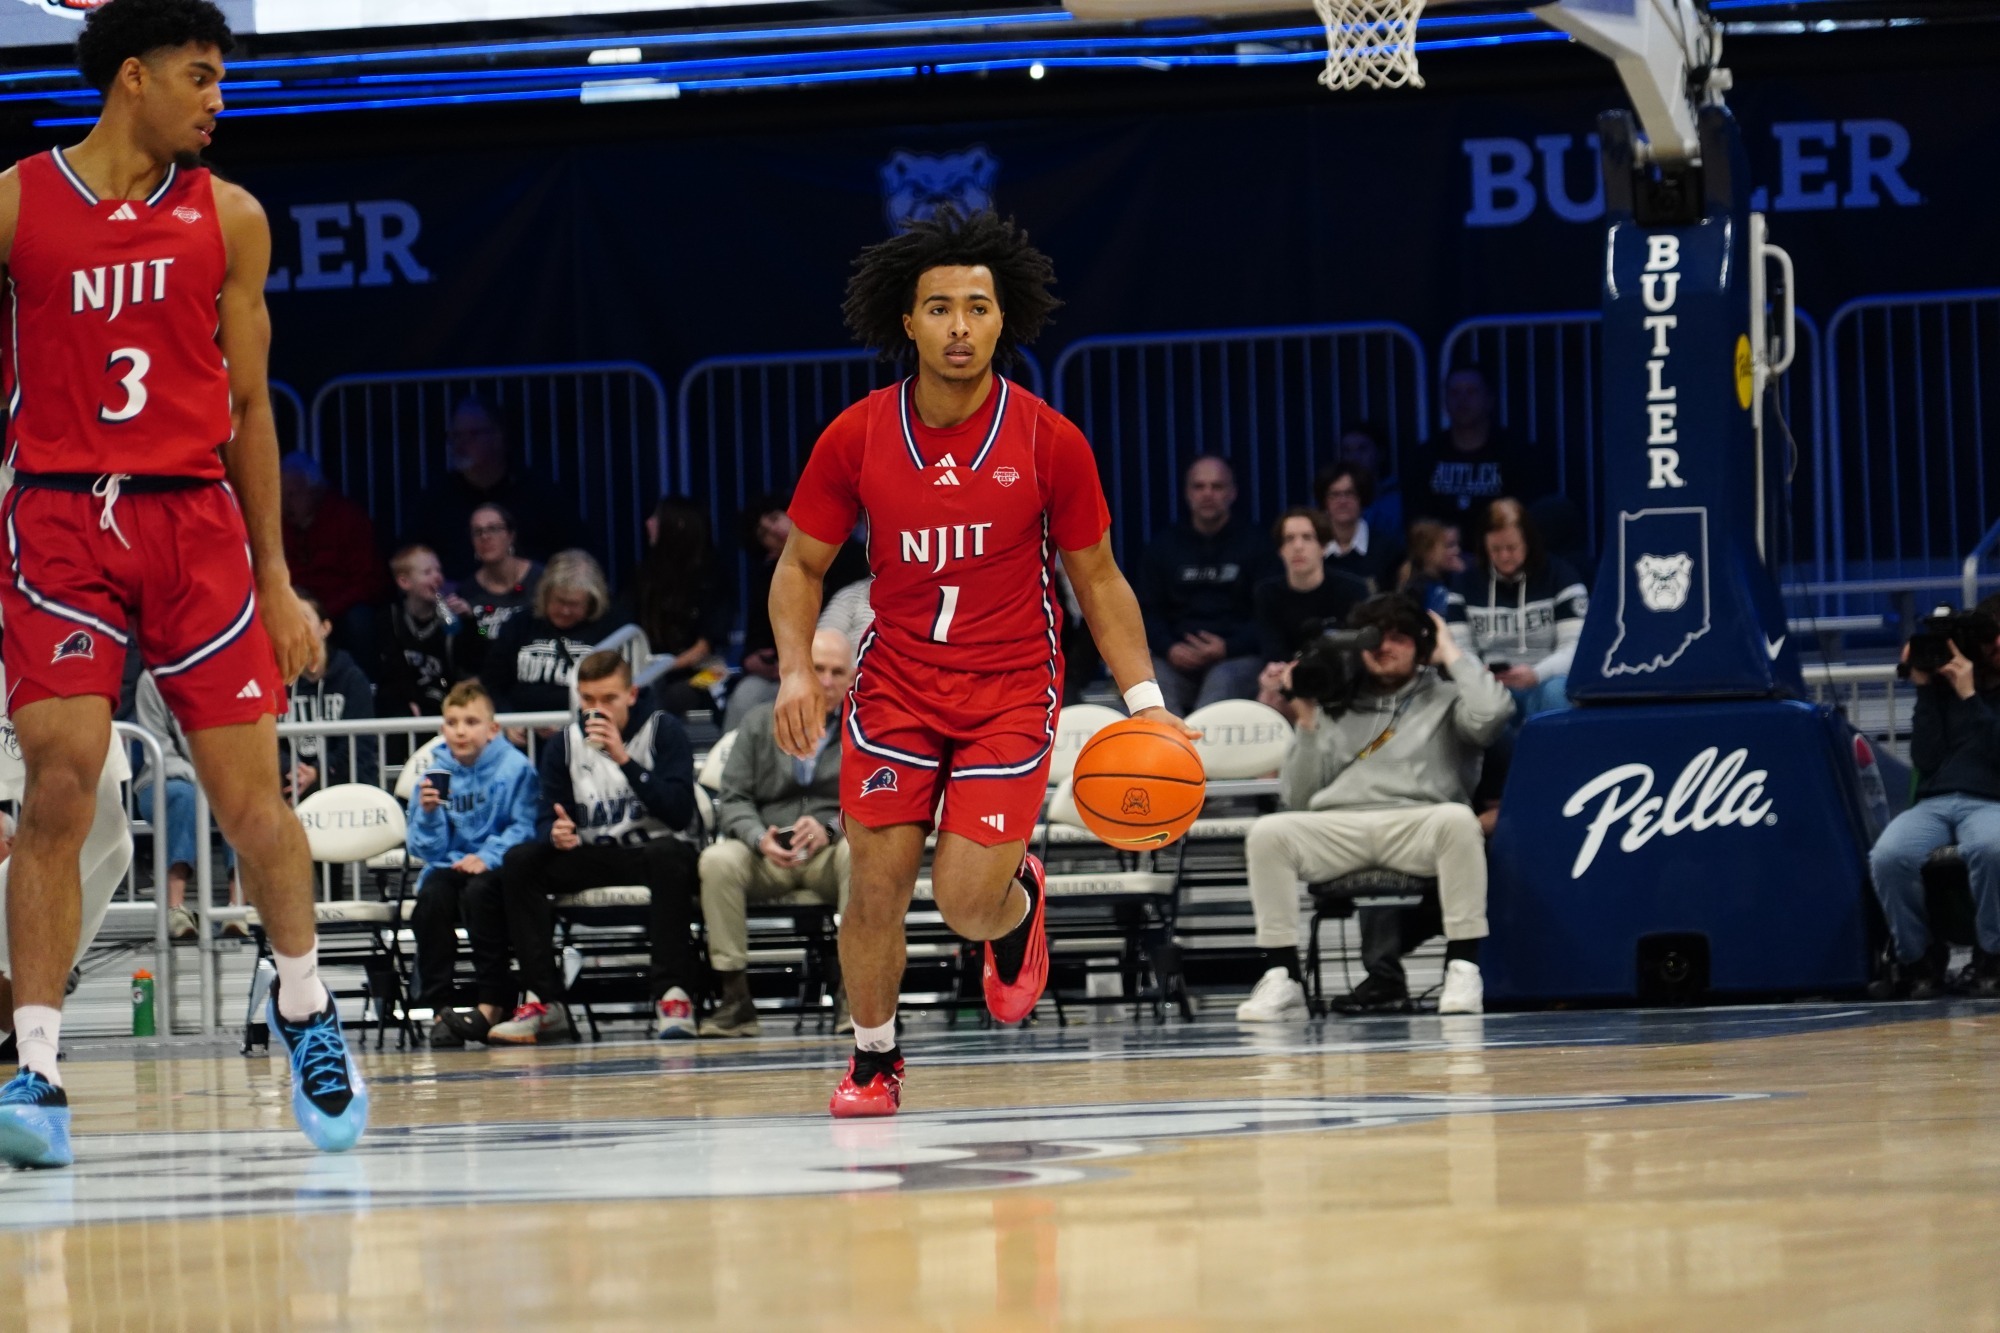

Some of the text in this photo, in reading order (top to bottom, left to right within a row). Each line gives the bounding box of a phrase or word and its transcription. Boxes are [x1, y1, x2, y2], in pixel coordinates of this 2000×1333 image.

[1462, 118, 1922, 228] BUER
[72, 257, 175, 323] NJIT
[97, 347, 151, 424] 3
[1639, 234, 1683, 489] BUTLER
[900, 522, 993, 574] NJIT
[929, 585, 960, 643] 1
[300, 807, 389, 830] BUTLER
